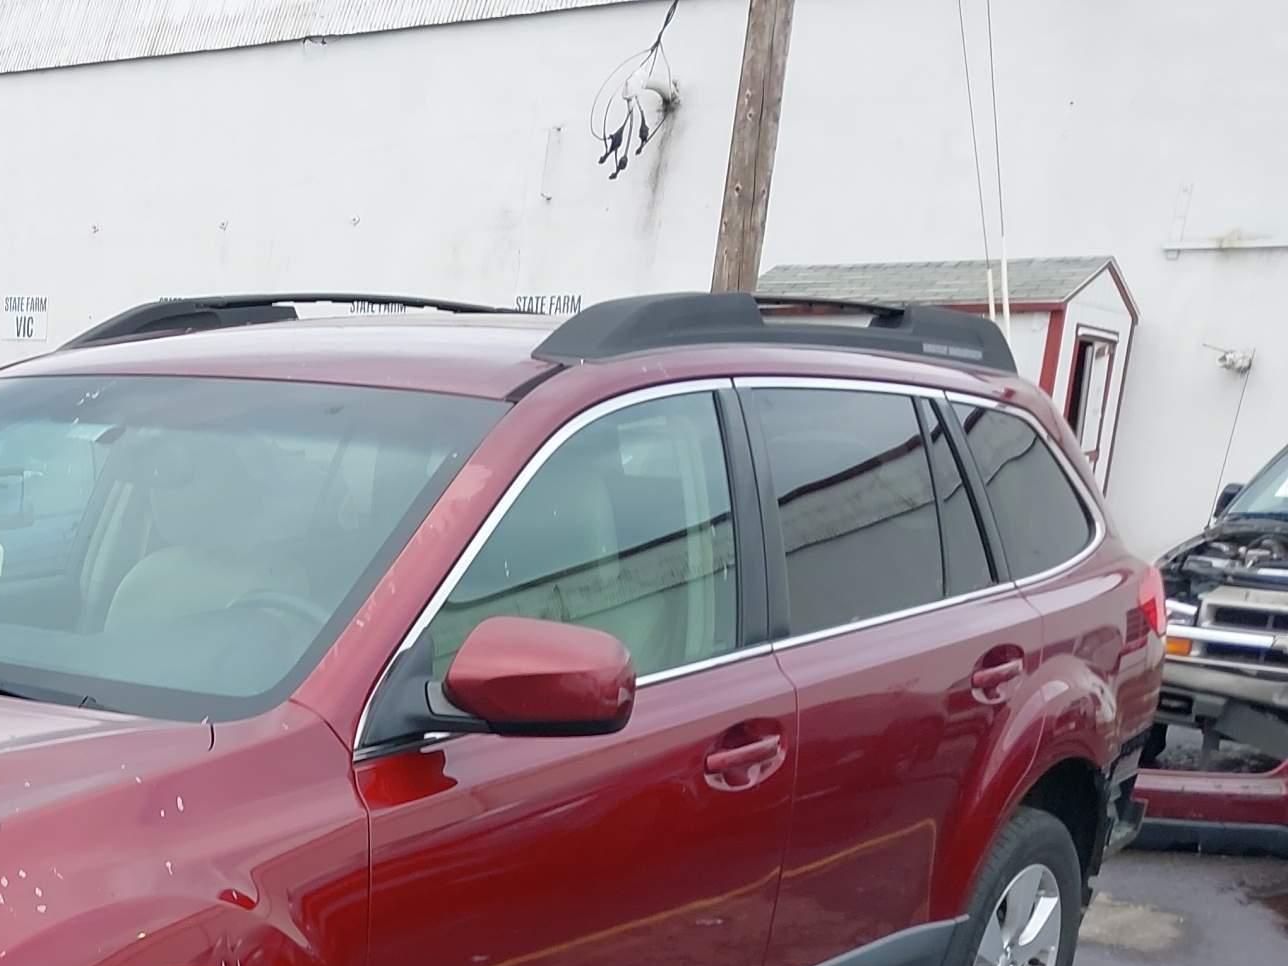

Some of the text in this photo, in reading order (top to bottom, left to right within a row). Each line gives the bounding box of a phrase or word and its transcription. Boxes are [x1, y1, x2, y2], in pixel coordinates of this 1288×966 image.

[4, 296, 48, 312] STATE FARM
[515, 294, 582, 315] STATE FARM
[16, 315, 34, 338] VIC
